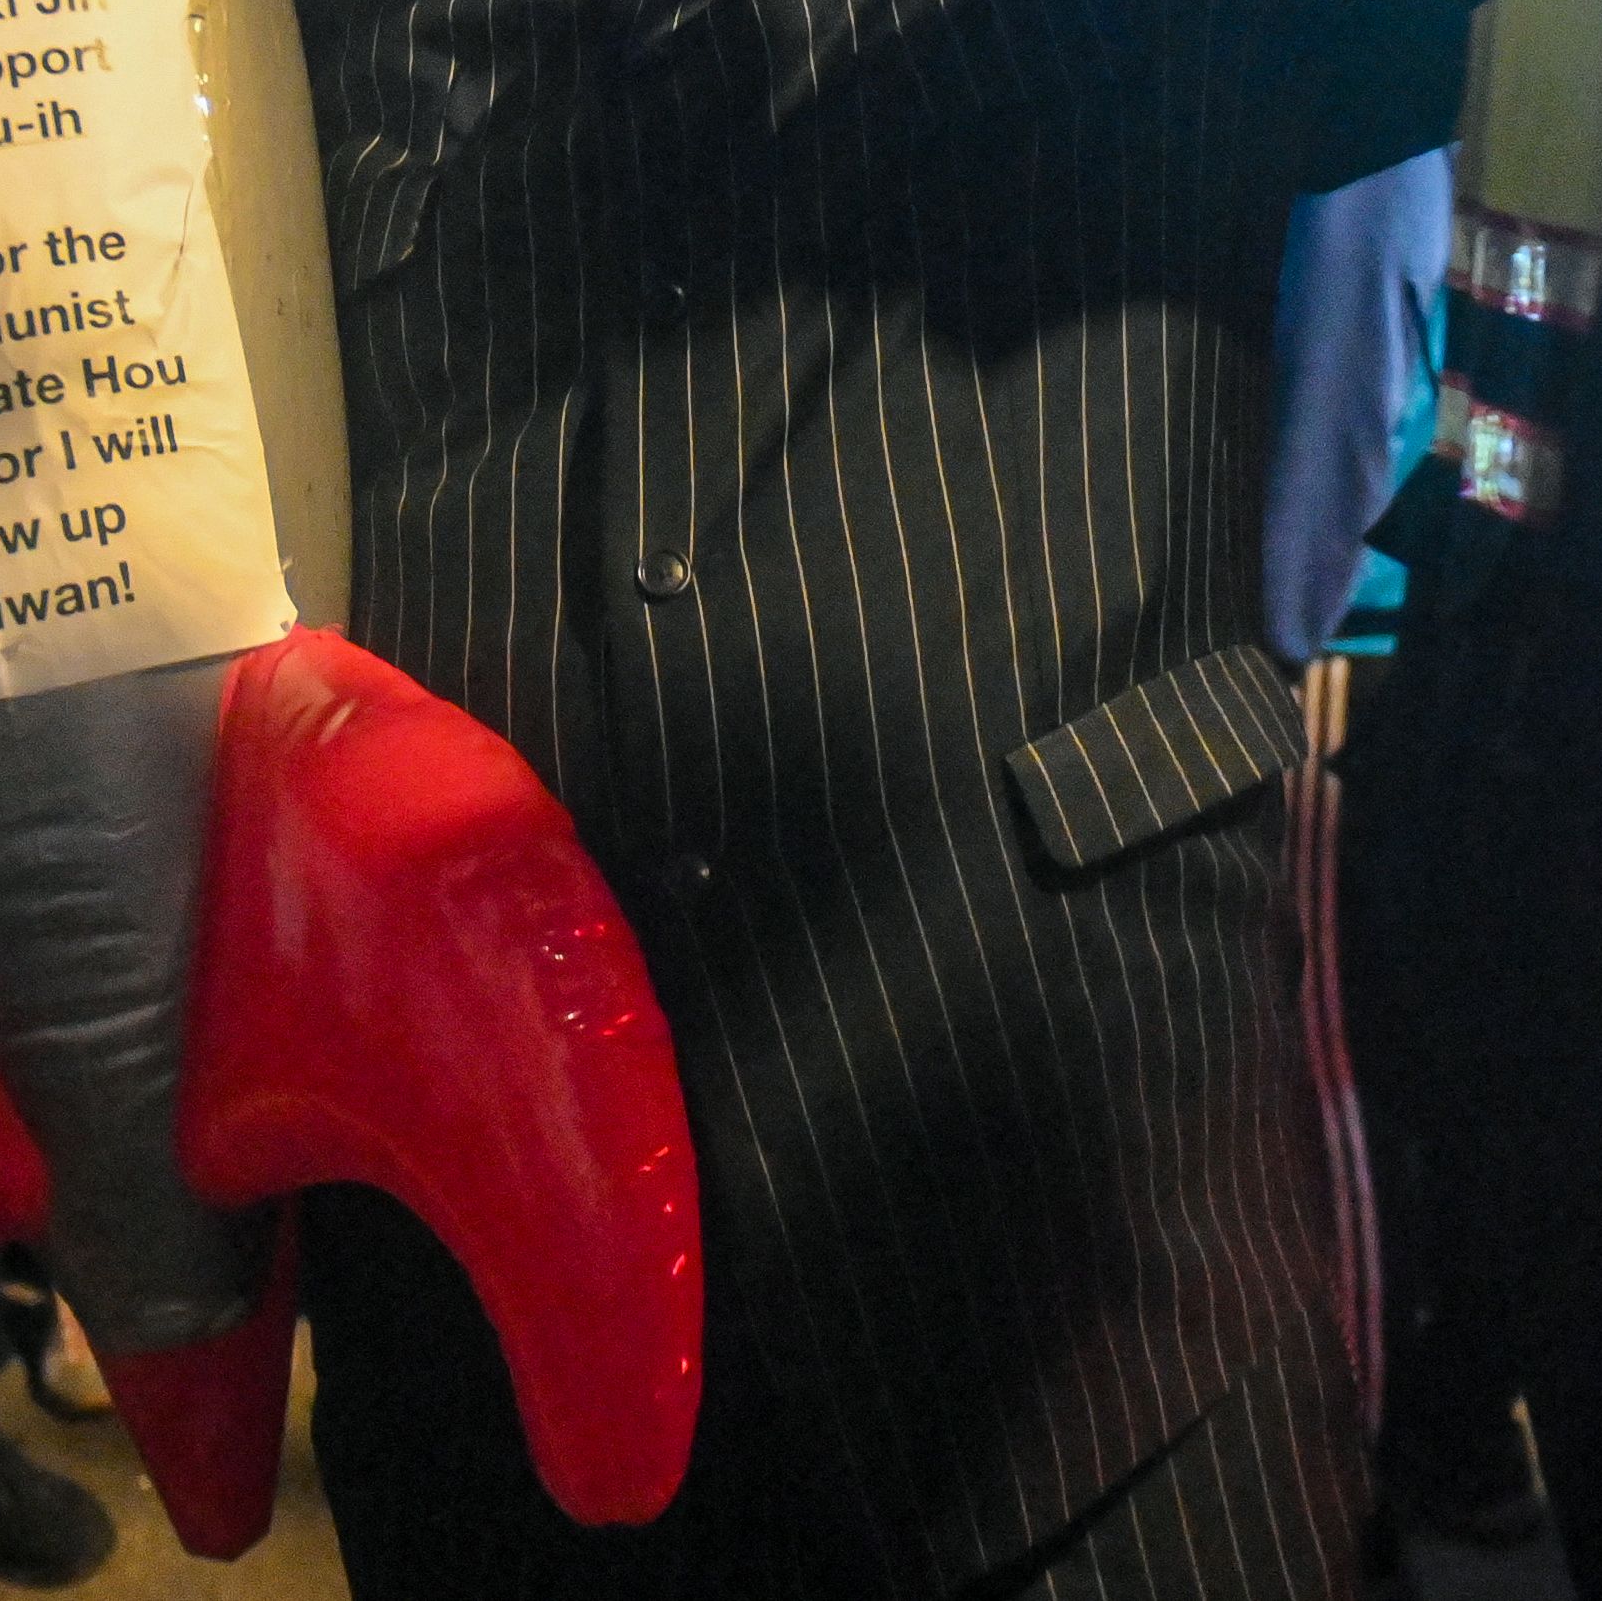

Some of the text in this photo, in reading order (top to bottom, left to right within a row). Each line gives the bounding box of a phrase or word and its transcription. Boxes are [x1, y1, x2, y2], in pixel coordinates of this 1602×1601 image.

[43, 226, 126, 266] the
[82, 355, 187, 397] Hou
[60, 430, 77, 470] I
[92, 414, 179, 464] will
[60, 502, 127, 546] up
